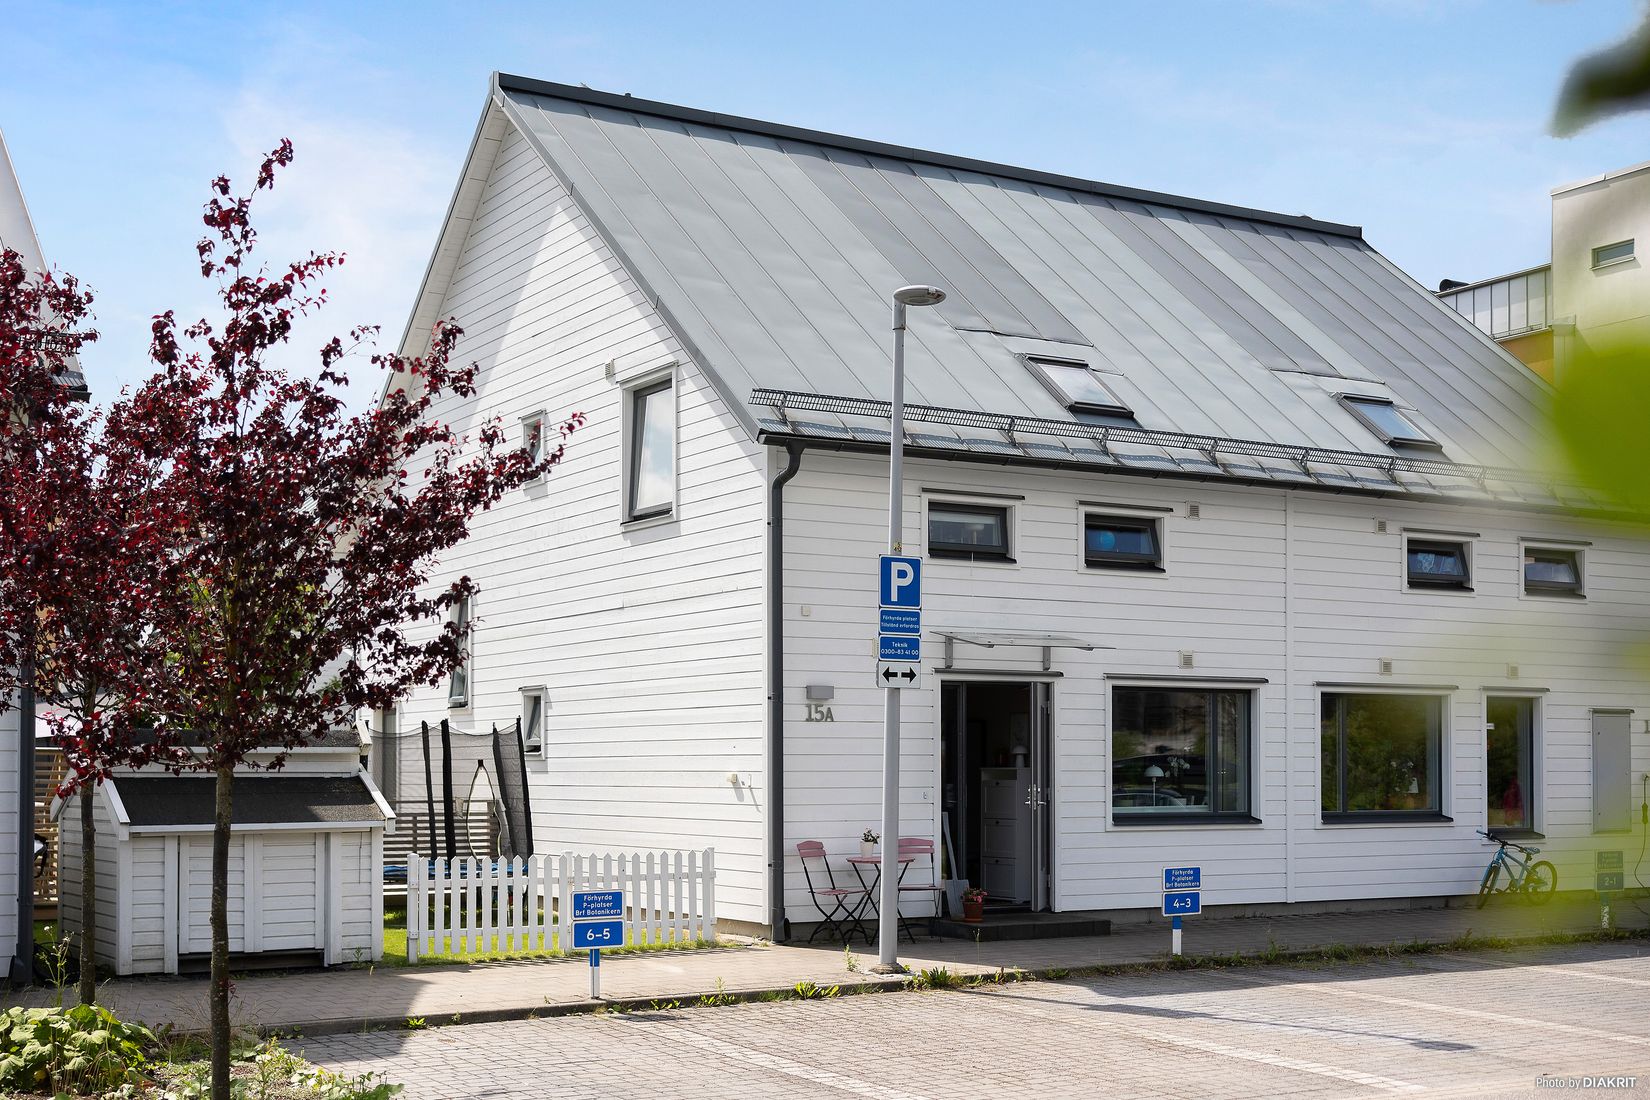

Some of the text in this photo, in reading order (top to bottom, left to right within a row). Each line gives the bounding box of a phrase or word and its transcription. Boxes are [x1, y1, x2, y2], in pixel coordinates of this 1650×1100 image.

[891, 561, 914, 602] P
[805, 704, 834, 722] 15A
[1173, 898, 1191, 908] 4-3
[586, 928, 611, 941] 6-5
